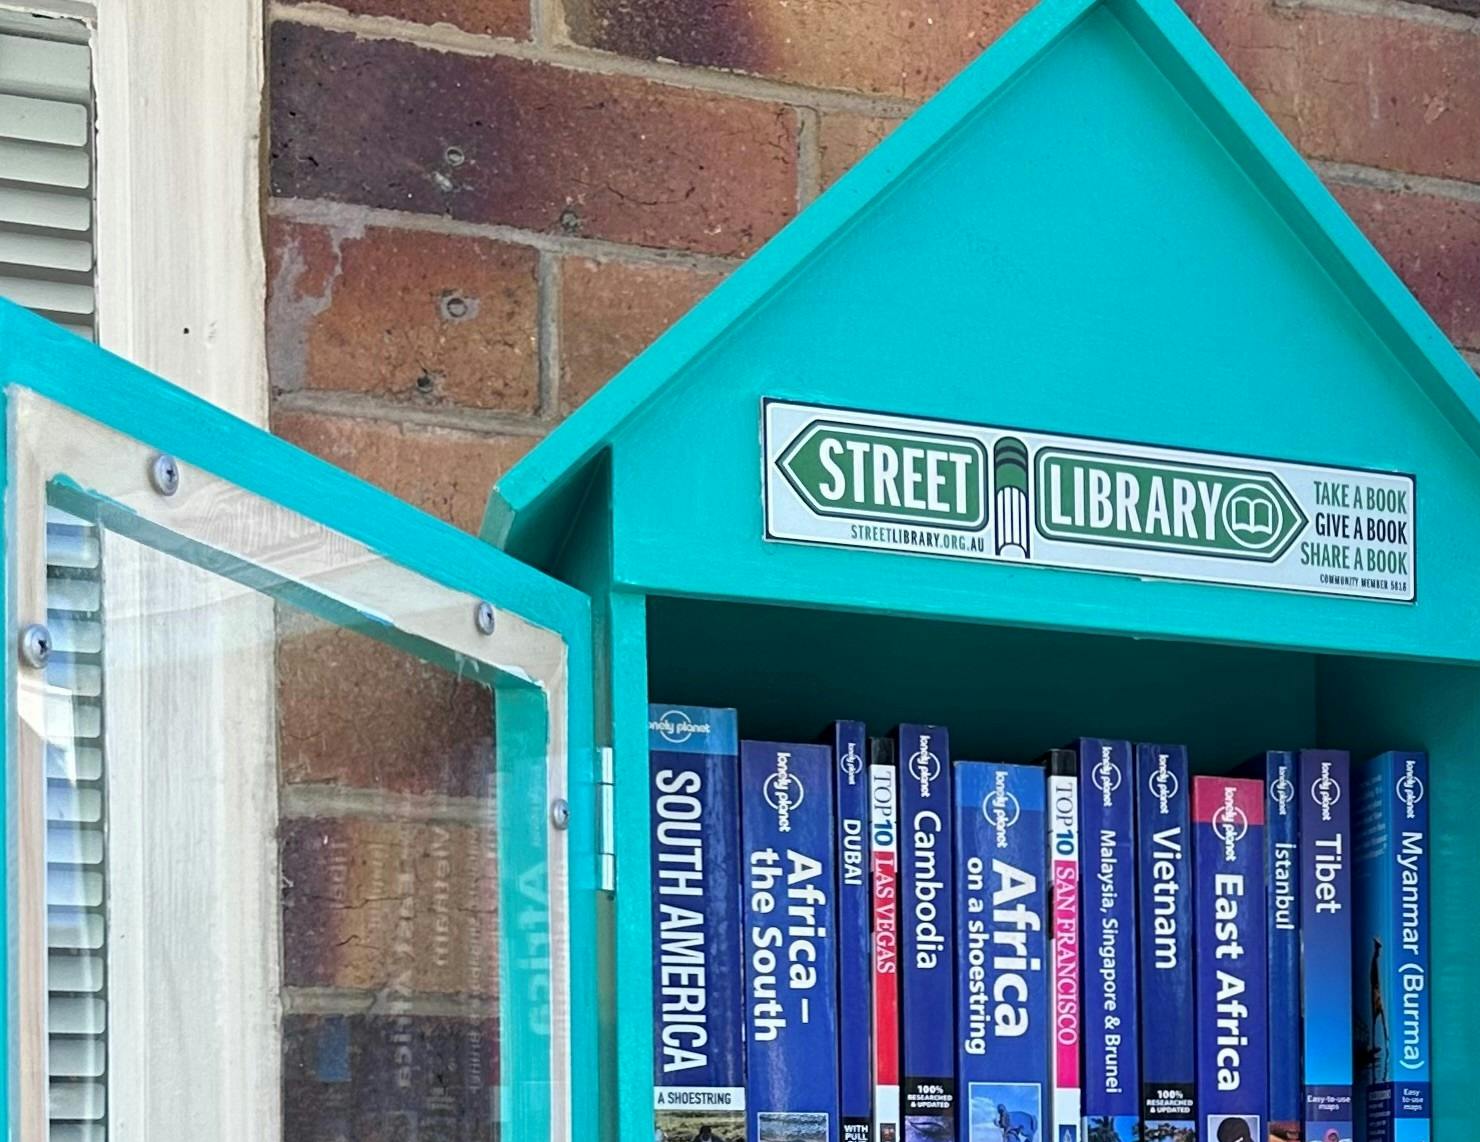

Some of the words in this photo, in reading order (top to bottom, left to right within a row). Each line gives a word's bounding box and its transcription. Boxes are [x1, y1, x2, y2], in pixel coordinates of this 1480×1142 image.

[819, 438, 973, 514] STREET
[1050, 463, 1223, 540] LIBRARY
[1314, 481, 1350, 508] TAKE
[1353, 485, 1363, 509] A
[1366, 487, 1407, 514] BOOK
[851, 524, 985, 553] STREETLIBRARY.ORG.AU
[1315, 512, 1350, 539] GIVE
[1353, 516, 1363, 540] A
[1367, 518, 1407, 545] BOOK
[1300, 541, 1350, 569] SHARE
[1353, 547, 1363, 571] A
[1367, 548, 1407, 575] BOOK
[1320, 574, 1359, 587] COMMUNITY
[1361, 577, 1388, 589] MEMBER
[676, 721, 711, 734] planet
[916, 735, 931, 765] lonely
[1100, 746, 1112, 775] lonely
[1156, 754, 1169, 782] lonely
[773, 752, 791, 790] lonely
[917, 765, 931, 798] planet
[992, 770, 1008, 807] lonely
[1318, 762, 1332, 790] lonely
[1403, 760, 1416, 788] lonely
[1100, 776, 1113, 807] planet
[1157, 783, 1170, 814] planet
[1221, 786, 1237, 824] lonely
[1319, 791, 1332, 821] planet
[1404, 789, 1416, 818] planet
[774, 791, 792, 832] planet
[993, 807, 1009, 849] planet
[656, 770, 704, 896] SOUTH
[1222, 824, 1238, 862] planet
[842, 818, 862, 886] DUBAI
[751, 848, 784, 913] the
[874, 857, 894, 899] LAS
[968, 857, 984, 889] on
[1056, 866, 1076, 911] SAN
[1097, 829, 1119, 913] Malaysia,
[1314, 833, 1343, 914] Tibet
[913, 810, 945, 970] Cambodia
[967, 897, 983, 912] a
[1152, 826, 1183, 970] Vietnam
[1397, 831, 1423, 955] Myanmar
[788, 850, 826, 989] Africa
[1214, 873, 1245, 960] East
[875, 903, 896, 974] VEGAS
[991, 858, 1042, 1038] Africa
[752, 920, 787, 1042] South
[1056, 918, 1079, 1046] FRANCISCO
[1098, 920, 1119, 1011] Singapore
[660, 903, 708, 1073] AMERICA
[965, 920, 986, 1056] shoestring
[1105, 1016, 1120, 1029] &
[1216, 970, 1249, 1091] Africa
[1402, 963, 1425, 1071] (Burma)
[1105, 1033, 1122, 1094] Brunei
[657, 1092, 665, 1104] A
[667, 1092, 732, 1105] SHOESTRING
[907, 1094, 954, 1102] RESEARCHED
[917, 1085, 944, 1094] 100%
[917, 1101, 950, 1109] UPDATED
[1157, 1089, 1184, 1099] 100%
[1307, 1095, 1351, 1104] Easy-to-use
[844, 1124, 869, 1133] WITH
[1156, 1106, 1191, 1114] UPDATED
[845, 1132, 868, 1141] PULL
